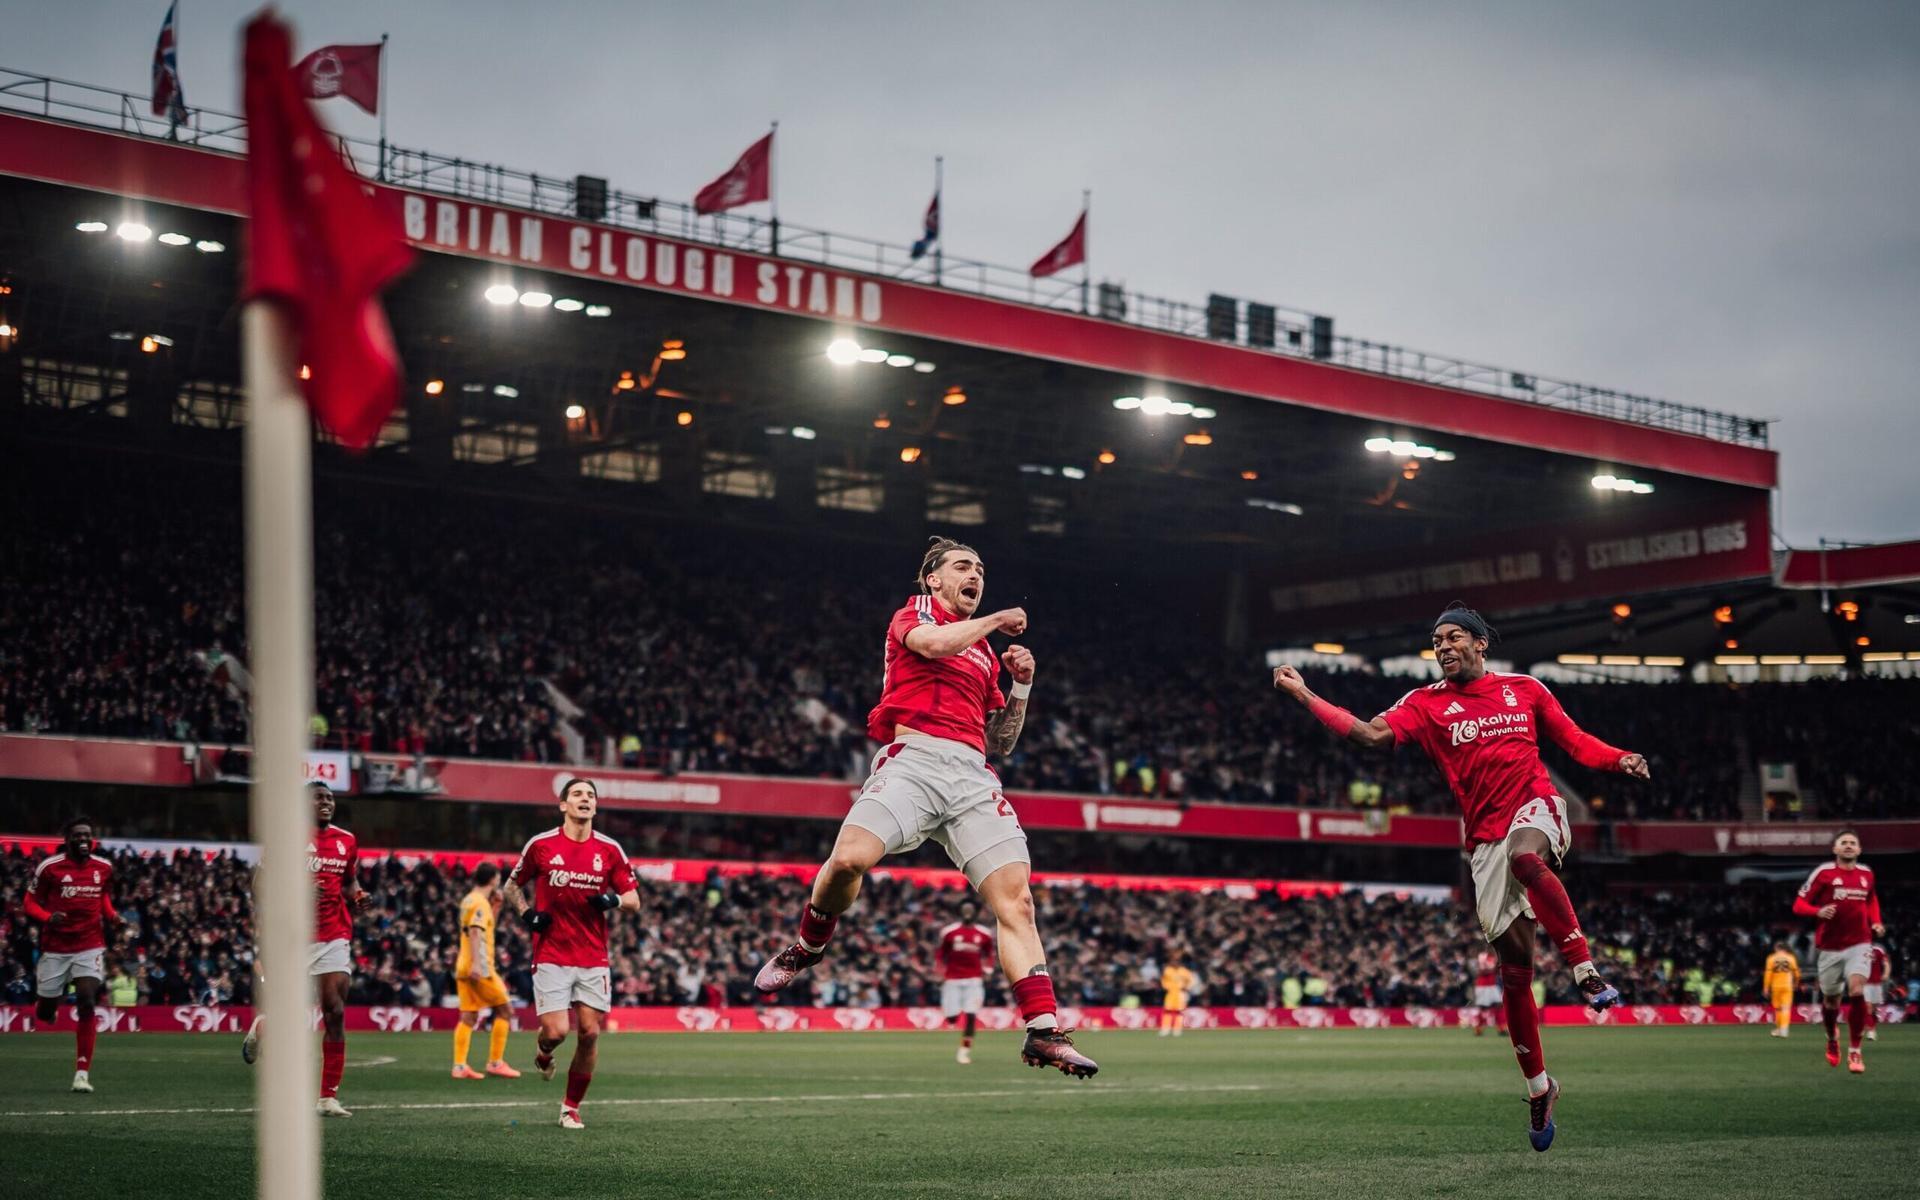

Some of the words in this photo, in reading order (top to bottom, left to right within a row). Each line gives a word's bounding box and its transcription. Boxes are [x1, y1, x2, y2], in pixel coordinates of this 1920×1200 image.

[404, 196, 543, 262] BRIAN
[570, 227, 734, 297] CLOUGH
[756, 262, 882, 322] STAND
[1587, 529, 1699, 570] ESTABLISHED
